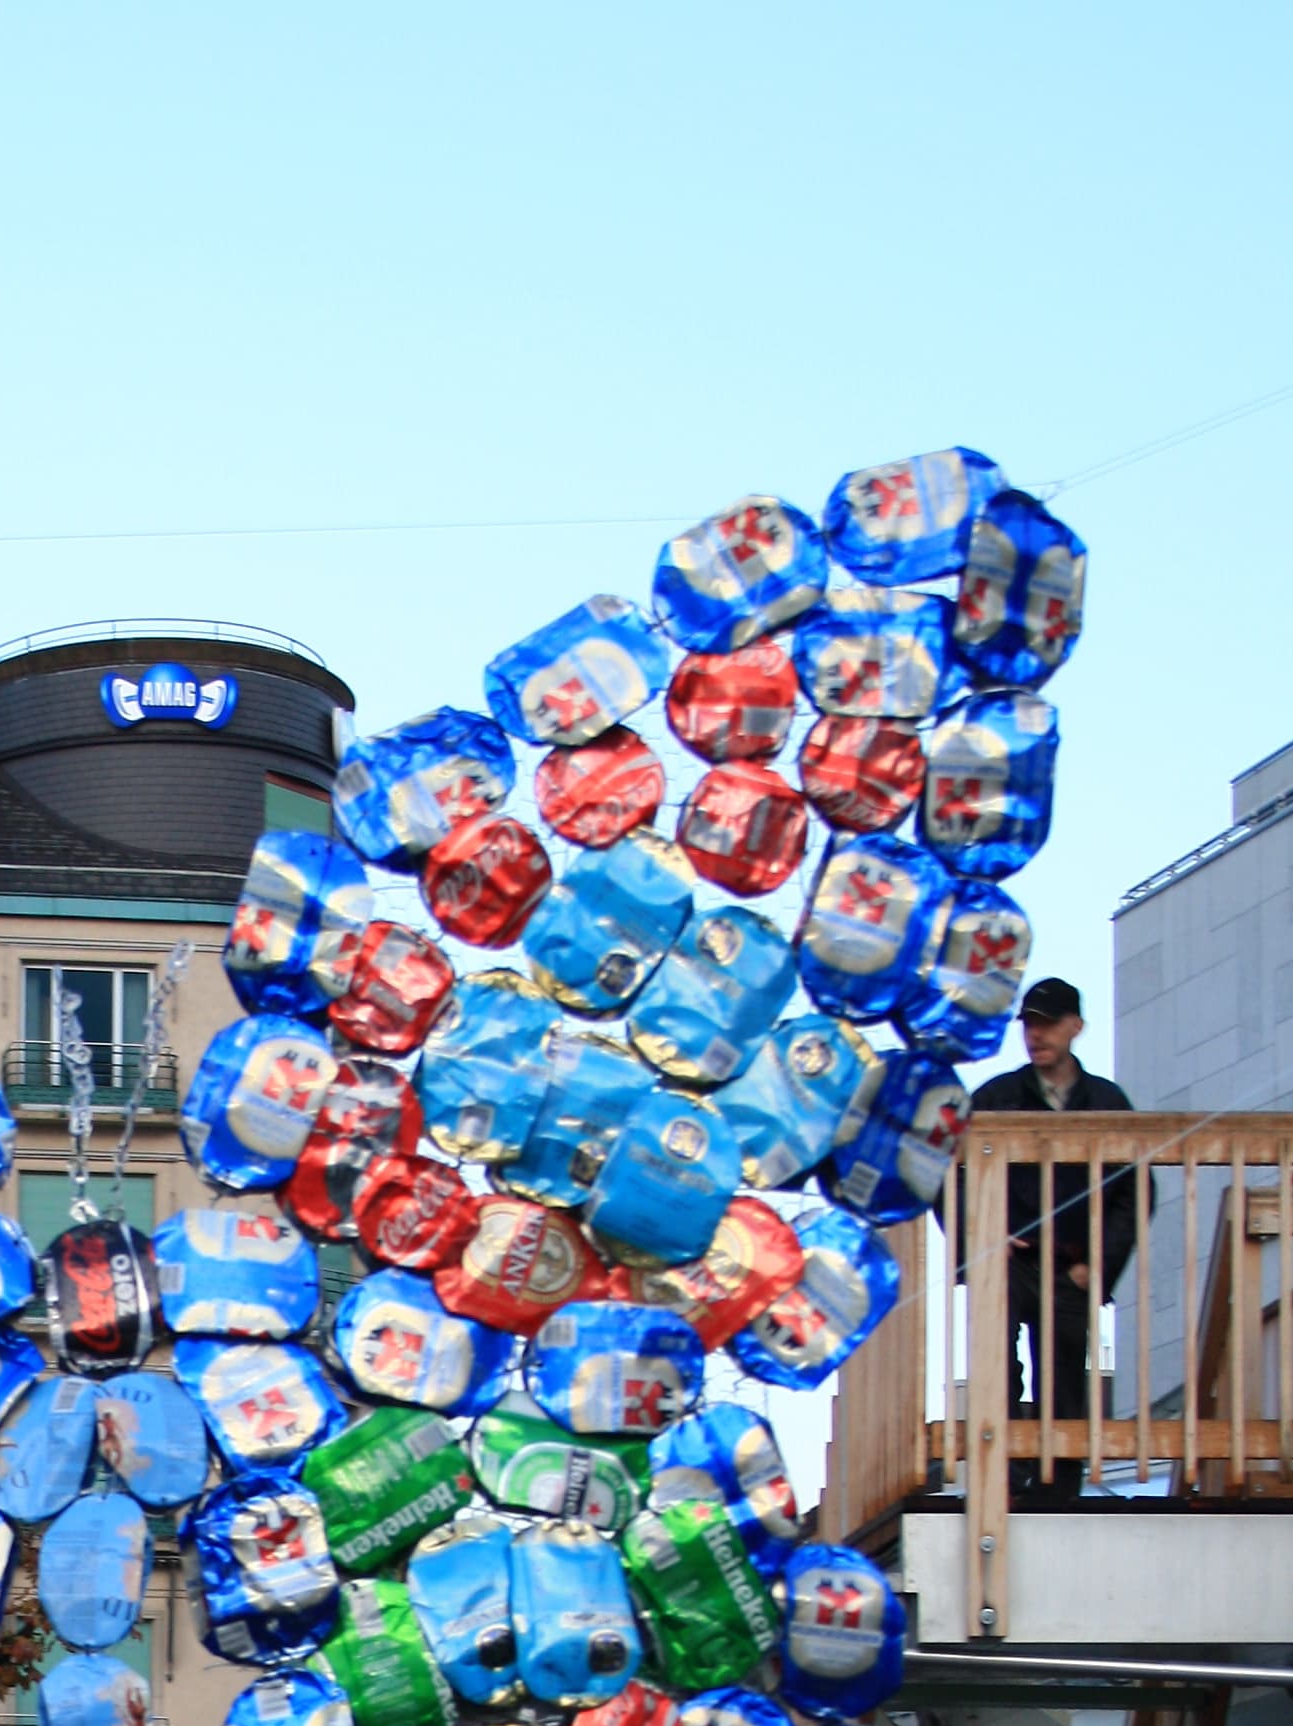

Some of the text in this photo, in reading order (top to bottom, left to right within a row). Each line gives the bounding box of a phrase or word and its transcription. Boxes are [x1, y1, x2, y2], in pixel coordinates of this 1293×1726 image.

[141, 682, 197, 708] AMAG
[110, 1252, 136, 1318] zero
[498, 1206, 546, 1296] ANKER
[335, 1481, 458, 1565] Heineken
[566, 1456, 590, 1518] Heine
[699, 1522, 778, 1652] Heineken
